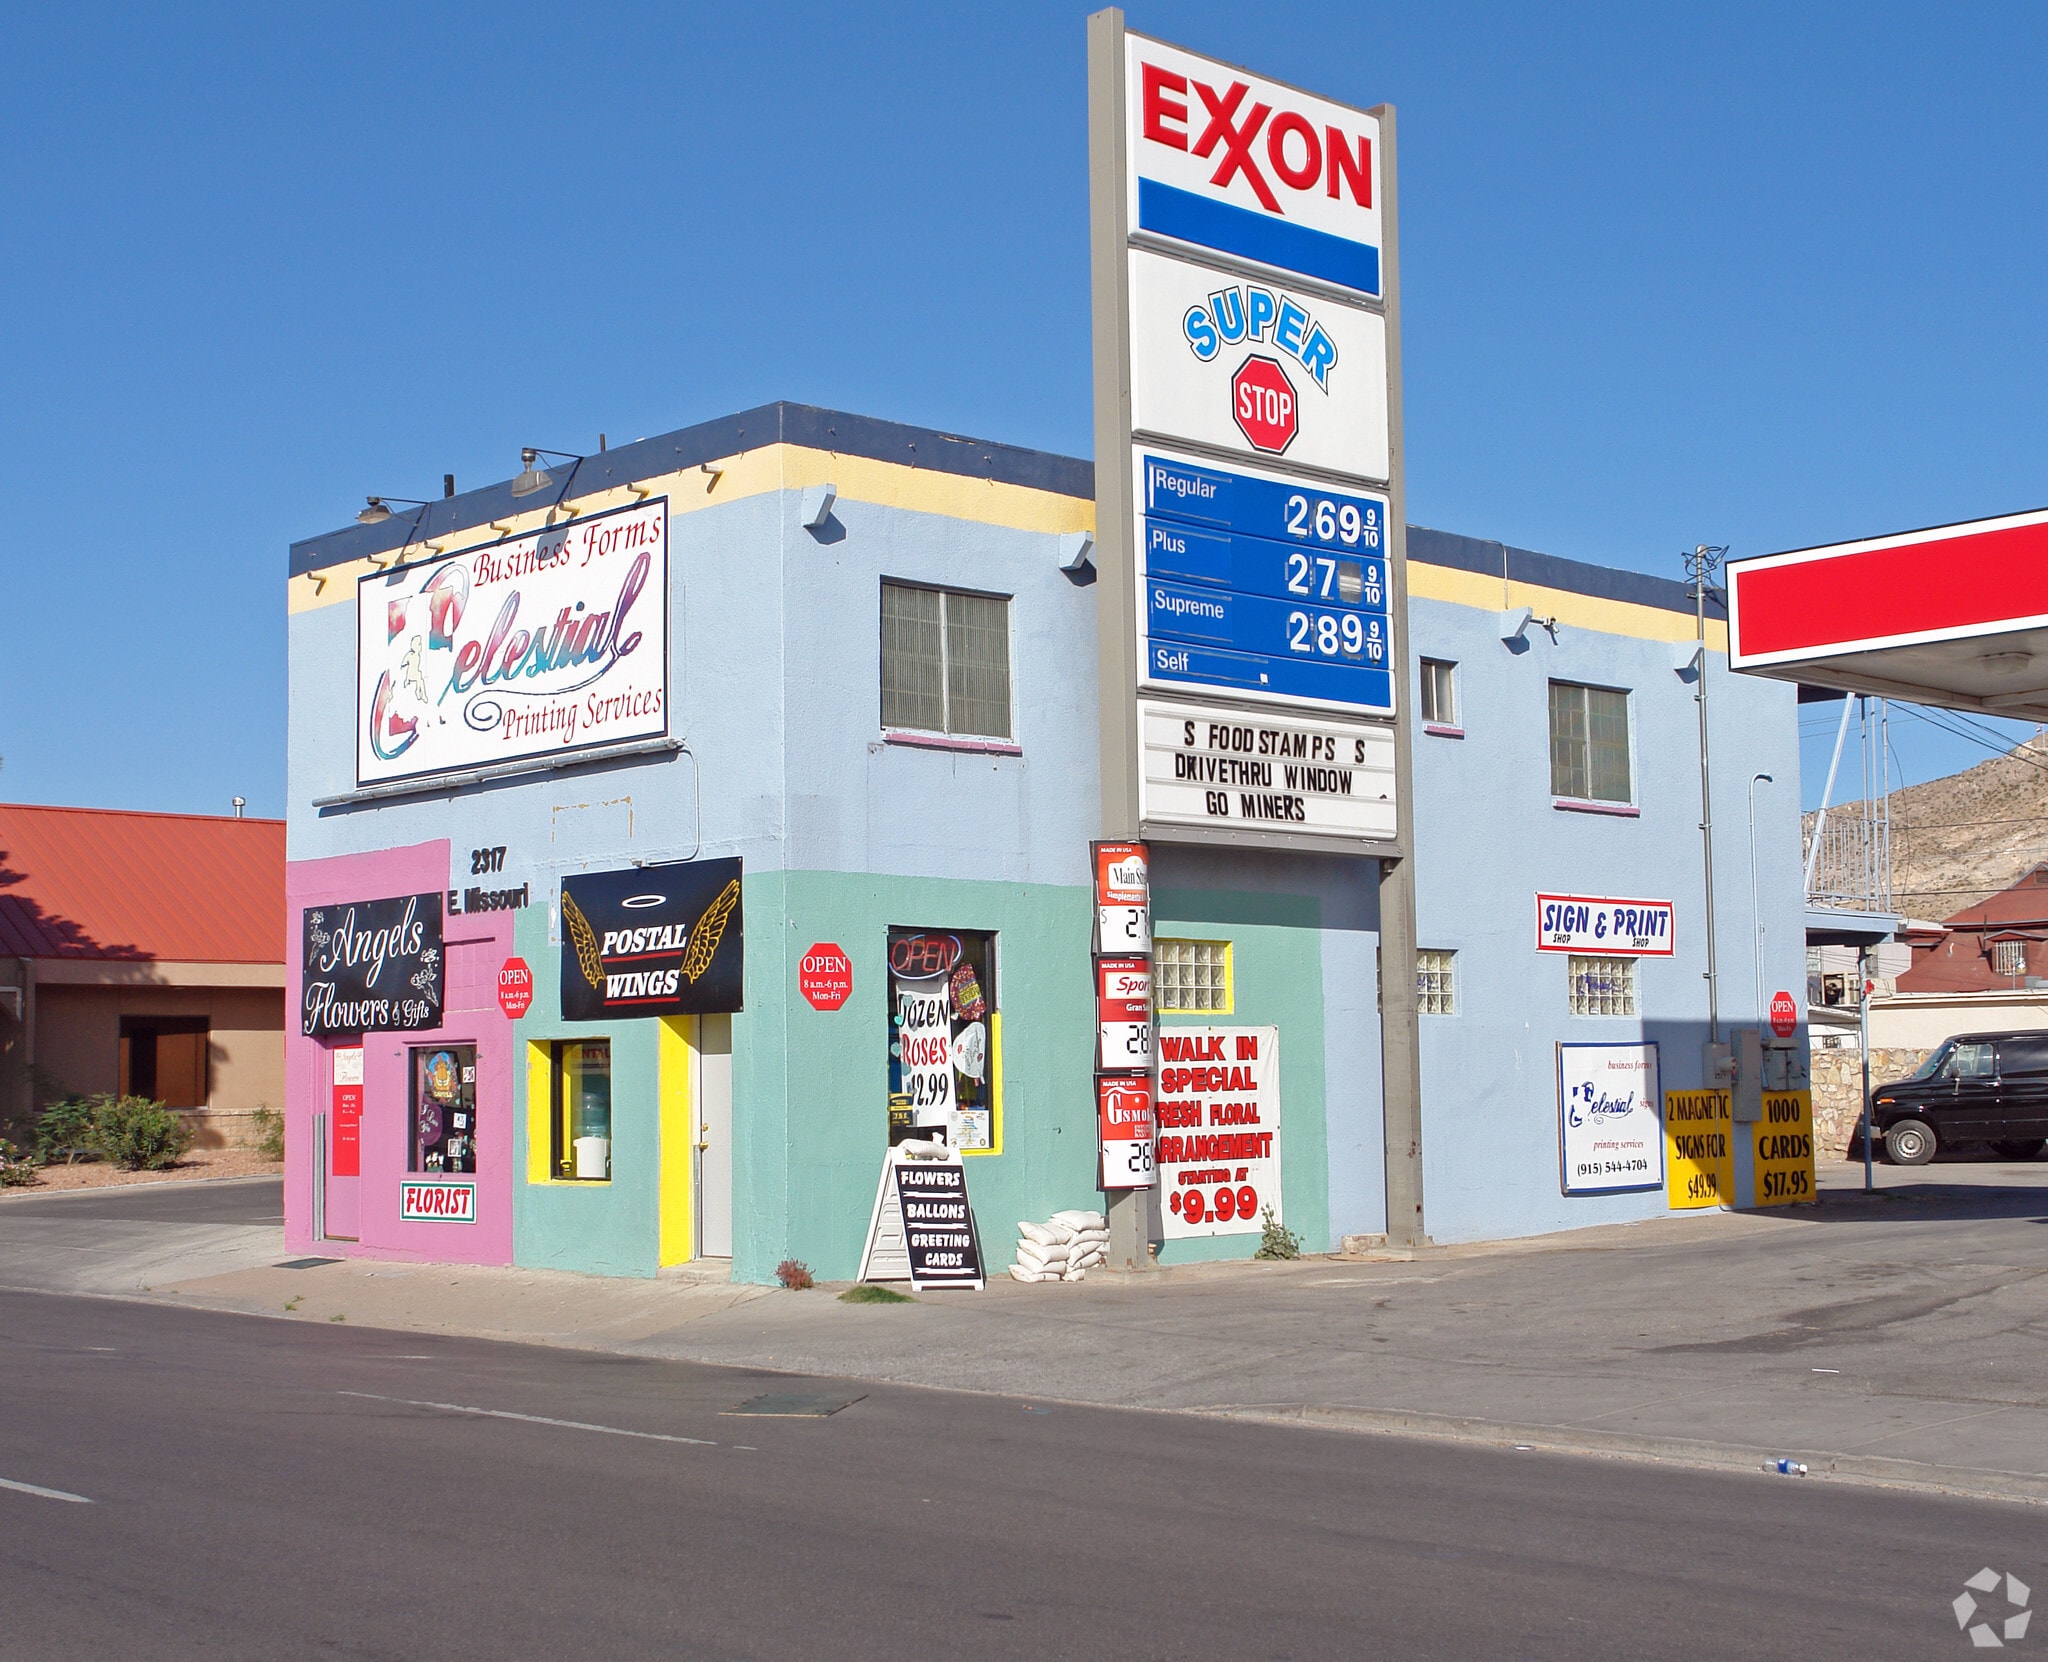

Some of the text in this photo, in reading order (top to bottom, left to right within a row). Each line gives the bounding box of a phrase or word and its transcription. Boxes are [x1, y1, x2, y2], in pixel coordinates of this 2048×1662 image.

[1141, 61, 1372, 215] EXXON
[1184, 285, 1338, 394] SUPER
[1239, 381, 1292, 428] STOP
[1155, 468, 1217, 499] Regular
[473, 516, 662, 587] Business Forms
[1152, 529, 1186, 554] Plus
[1154, 590, 1224, 619] Supreme
[1157, 649, 1189, 672] Self
[502, 684, 662, 744] Printing Services
[1284, 765, 1352, 794] WINDOW
[1206, 791, 1305, 821] GO MINERS
[471, 846, 507, 875] 2317
[1113, 867, 1136, 885] Main
[464, 882, 529, 914] Missouri
[1543, 904, 1668, 938] SIGN & PRINT
[320, 896, 424, 988] Angels
[600, 923, 687, 955] POSTAL
[1552, 933, 1571, 944] SHOP
[1632, 938, 1650, 947] SHOP
[803, 956, 846, 973] OPEN
[891, 938, 956, 973] OPEN
[499, 969, 529, 985] OPEN
[606, 969, 680, 999] WINGS
[803, 979, 809, 988] 8
[1116, 976, 1150, 995] Spor
[304, 981, 389, 1034] Flowers
[402, 999, 430, 1027] Gifts
[812, 991, 841, 1000] Mon-Fri
[1772, 1000, 1794, 1013] OPEN
[902, 1033, 947, 1066] ROSES
[1160, 1036, 1258, 1062] WALK IN
[1607, 1059, 1652, 1071] business forms
[1161, 1066, 1258, 1093] SPECIAL
[1155, 1100, 1260, 1128] RESH FLORAL
[1669, 1094, 1729, 1121] 2 MAGNETIC
[1767, 1098, 1800, 1123] 1000
[1593, 1139, 1644, 1151] printing services
[1675, 1134, 1726, 1160] SIGNS FOR
[1759, 1134, 1810, 1160] CARDS
[901, 1171, 961, 1187] FLOWERS
[1178, 1167, 1249, 1185] STARTING AT
[1577, 1159, 1648, 1177] (915) 544-4704
[1687, 1173, 1717, 1201] $49.99
[1763, 1169, 1808, 1201] $17.95
[406, 1187, 471, 1215] FLORIST
[907, 1203, 966, 1219] BALLONS
[1170, 1185, 1258, 1224] $9.99
[911, 1233, 971, 1248] GREETING
[925, 1252, 963, 1267] CARDS
